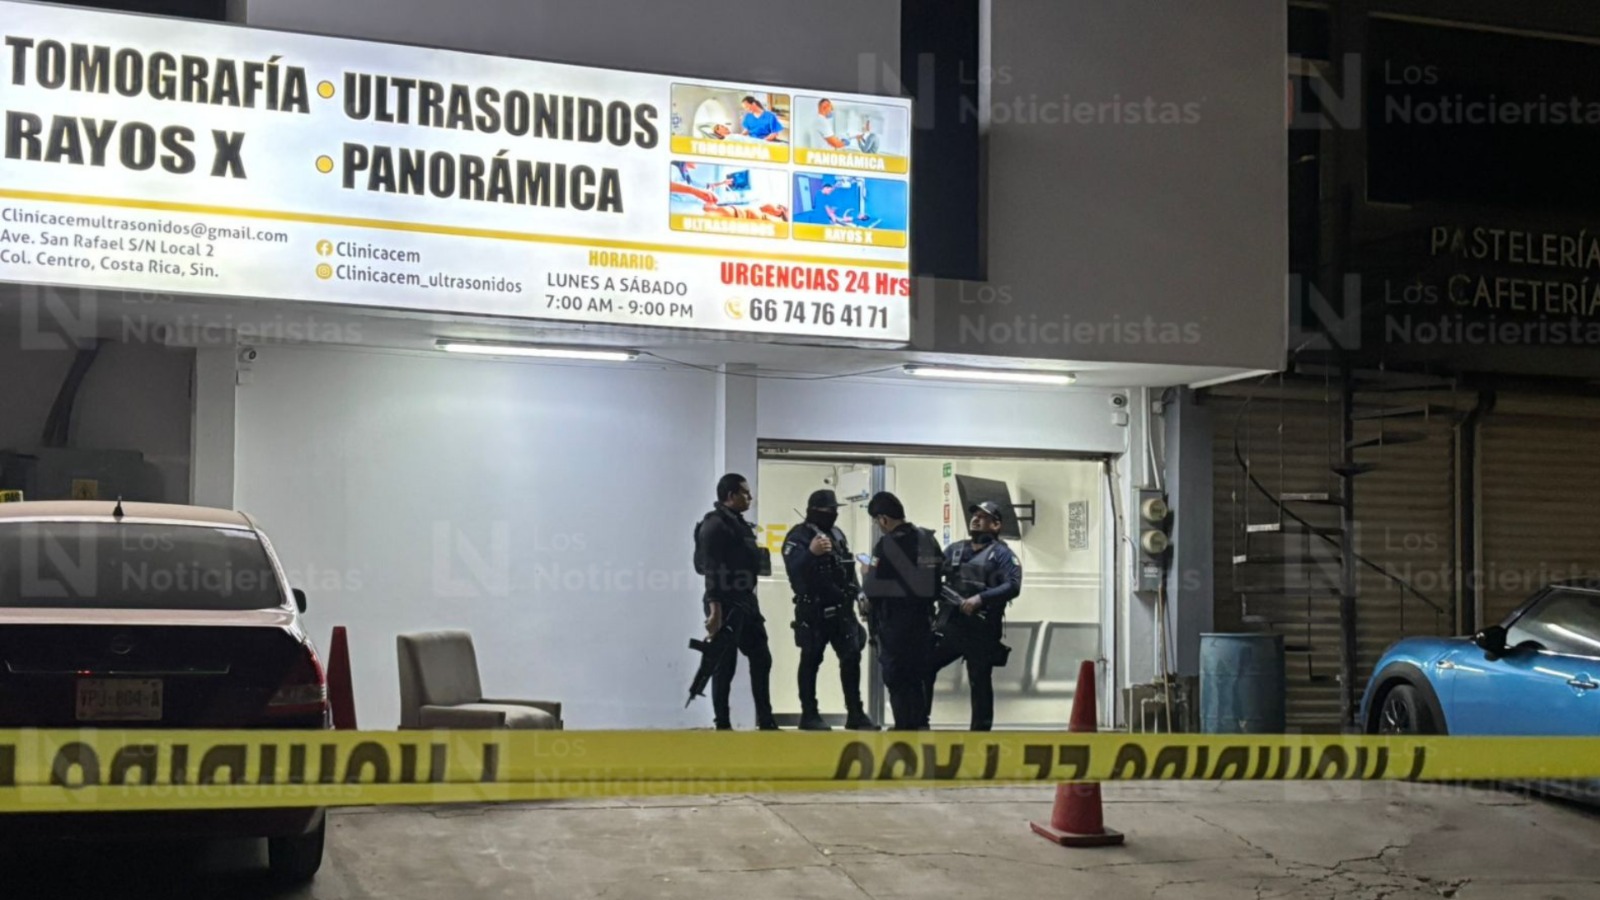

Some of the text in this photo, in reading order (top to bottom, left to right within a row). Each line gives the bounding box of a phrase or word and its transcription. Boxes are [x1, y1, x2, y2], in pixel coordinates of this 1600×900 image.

[5, 35, 310, 114] TOMOGRAFÍA
[343, 71, 659, 149] ULTRASONIDOS
[5, 109, 247, 179] RAYOS X
[806, 150, 886, 171] PANORÁMICA
[342, 141, 623, 213] PANORÁMICA
[0, 229, 215, 257] Ave. San Rafael S/N Local 2
[823, 227, 873, 244] RAYOS X
[0, 249, 219, 278] Col. Centro, Costa Rica, Sin.
[336, 241, 421, 264] Clinicacem
[588, 250, 658, 272] HORARIO:
[336, 264, 523, 294] Clinicacem_ultrasonidos
[547, 272, 688, 297] LUNES A SÁBADO
[720, 262, 910, 297] URGENCIAS 24 Hrs
[545, 294, 583, 312] 7:00
[587, 297, 614, 314] AM
[628, 299, 665, 316] 9:00
[670, 303, 694, 319] PM
[750, 298, 888, 329] 66 74 76 41 71
